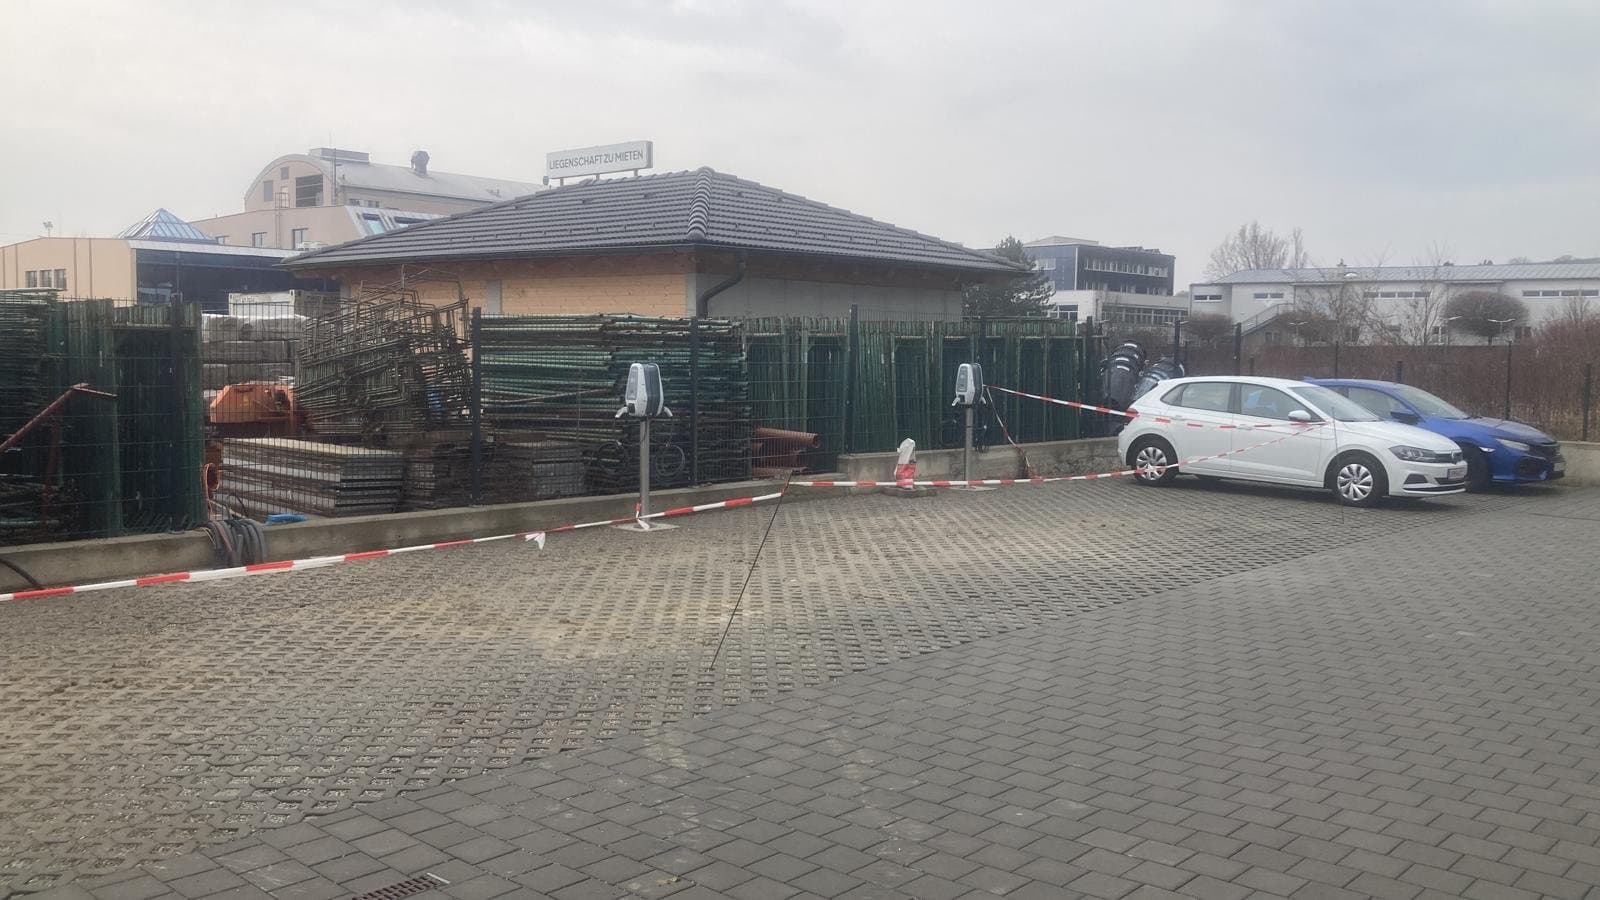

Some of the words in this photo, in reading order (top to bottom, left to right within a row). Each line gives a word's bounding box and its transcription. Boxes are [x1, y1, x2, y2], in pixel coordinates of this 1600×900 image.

[549, 154, 603, 169] LIEGENSCHAFT
[604, 153, 614, 163] ZU
[615, 150, 643, 162] MIETEN
